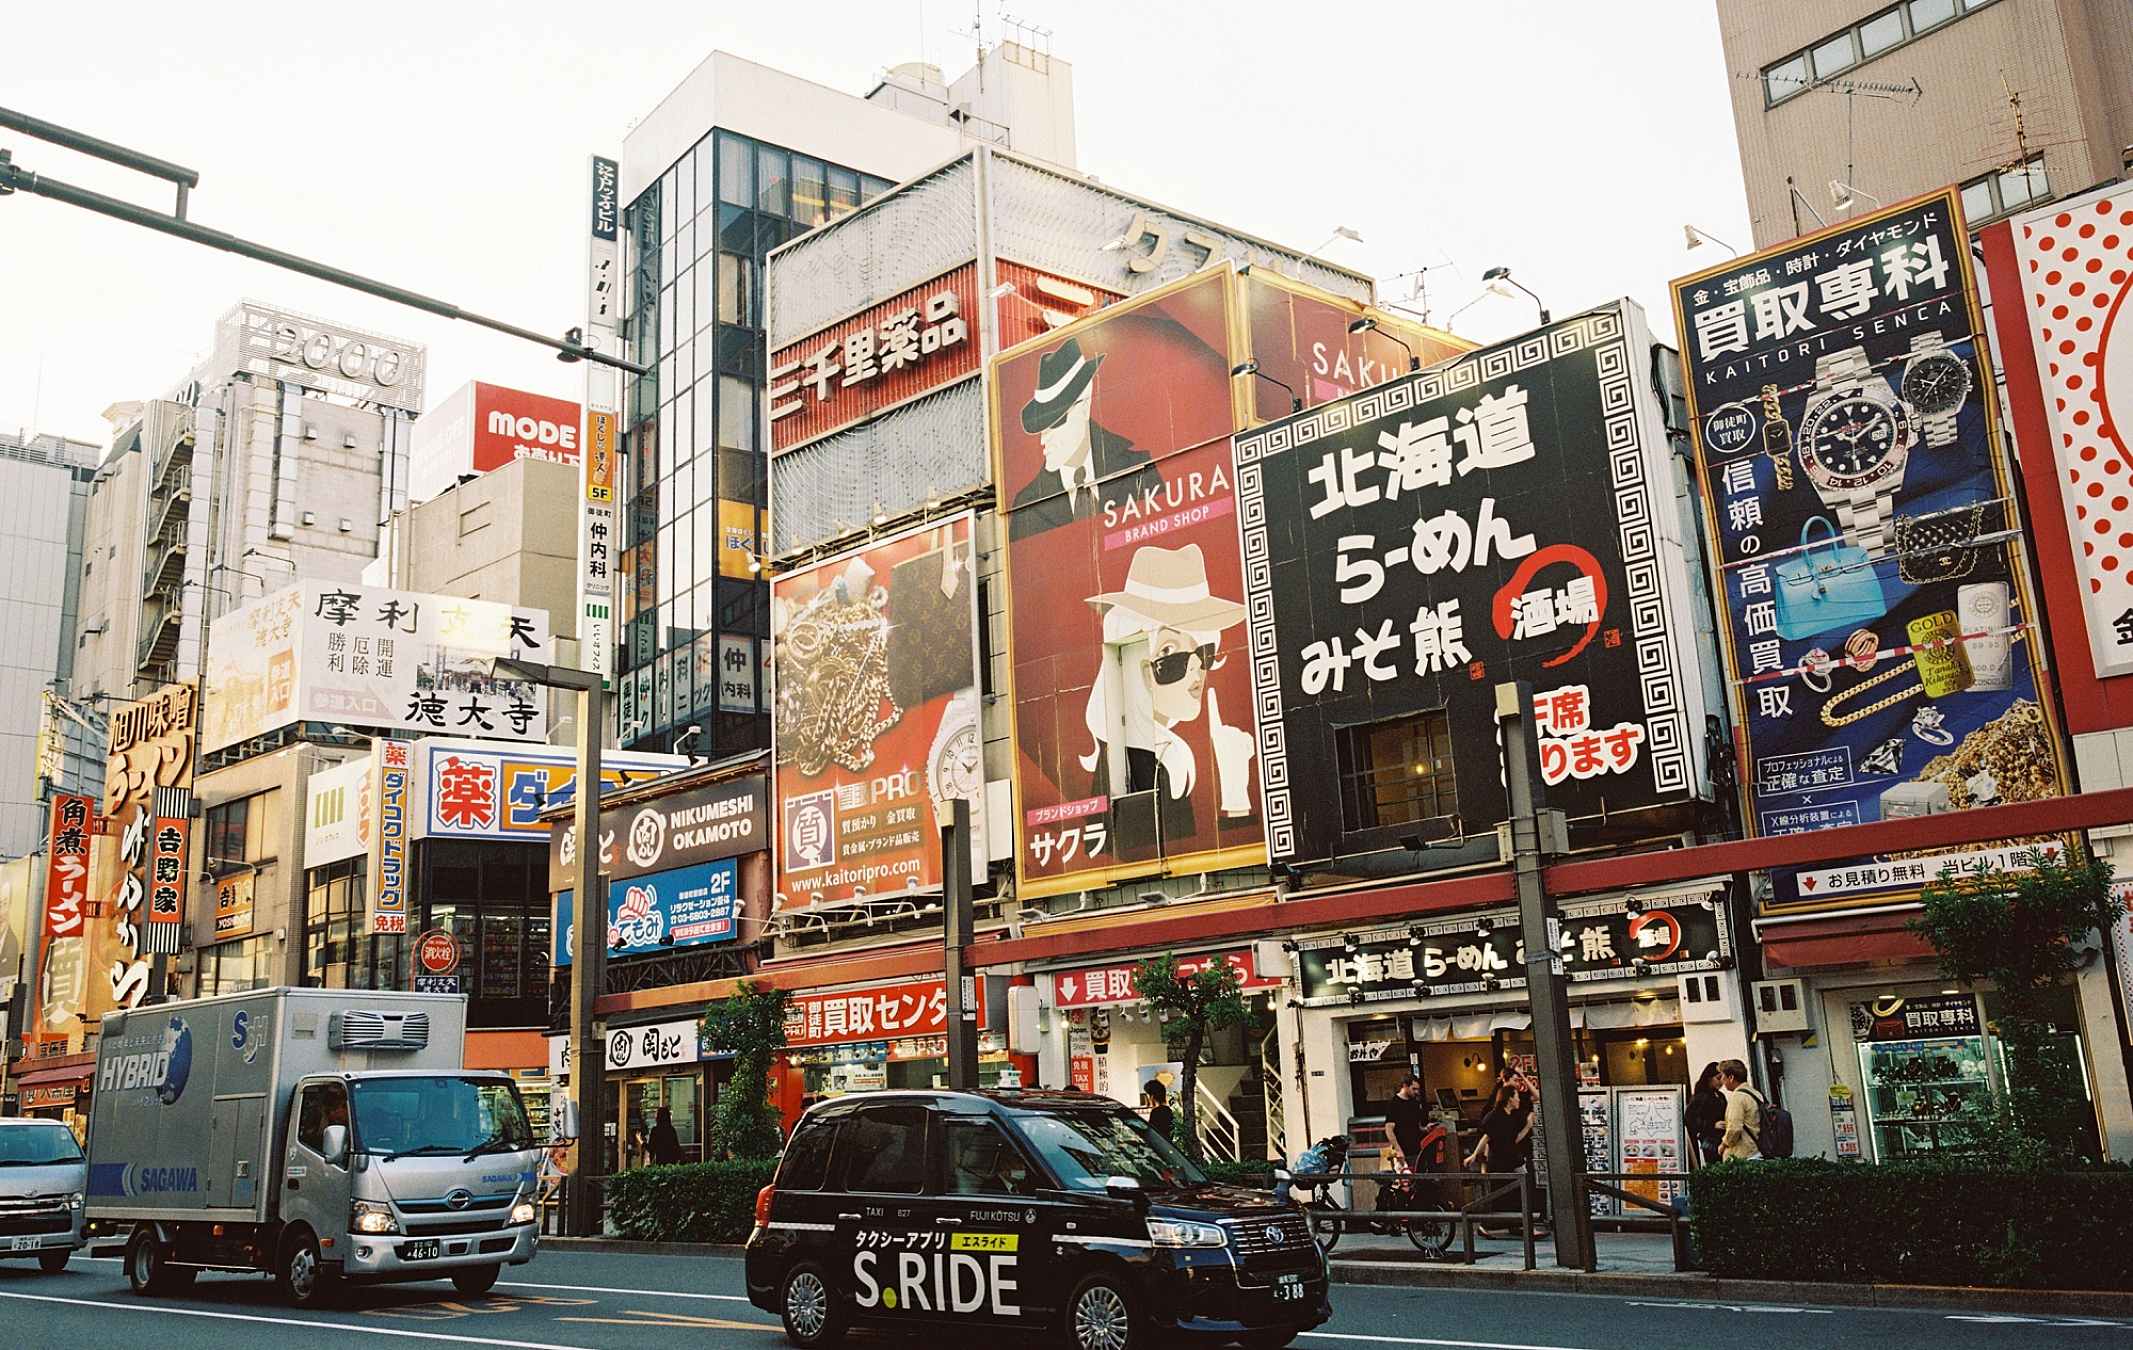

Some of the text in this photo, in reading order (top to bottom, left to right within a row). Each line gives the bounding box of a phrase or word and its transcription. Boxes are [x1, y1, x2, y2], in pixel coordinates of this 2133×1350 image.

[1693, 235, 1949, 363] 買取専科
[770, 289, 967, 421] 三千里薬品
[1705, 303, 1953, 386] KAITORI SENCA
[1307, 384, 1537, 521] 北海道
[592, 487, 608, 499] 5F
[1103, 463, 1231, 528] SAKURA
[1124, 505, 1210, 543] BRAND SHOP
[590, 522, 608, 579] 仲内科
[1334, 497, 1539, 604] らーめん
[1510, 575, 1600, 640] 酒場
[1721, 460, 1794, 719] 信頼の高価買取
[327, 631, 347, 673] 勝利
[351, 635, 371, 676] 厄除
[375, 637, 395, 679] 開運
[1300, 597, 1473, 696] みそ熊
[403, 691, 541, 735] 徳大寺
[385, 742, 407, 766] 薬
[436, 756, 496, 829] 薬
[1766, 766, 1846, 792] 正確な査定
[670, 794, 754, 829] NIKUMESHI
[381, 771, 406, 907] ダイコクドラッグ
[672, 818, 753, 850] OKAMOTO
[1029, 822, 1108, 867] サクラ
[49, 800, 90, 935] 角煮ラーメン
[710, 870, 731, 894] 2F
[791, 858, 921, 893] www.kaitoripro.com
[1827, 863, 1926, 890] お見積り無料
[375, 916, 405, 933] 免税
[1325, 949, 1415, 986] 北海道
[1423, 942, 1508, 978] らーめん
[824, 987, 979, 1037] 買取センタ
[1905, 1007, 1975, 1028] 買取専科
[100, 1052, 171, 1091] HYBRID
[140, 1165, 201, 1193] SAGAWA
[866, 1206, 884, 1217] TAXI
[855, 1230, 946, 1249] タクシーアプリ
[961, 1236, 1007, 1248] エスライド
[853, 1250, 1022, 1316] S.RIDE
